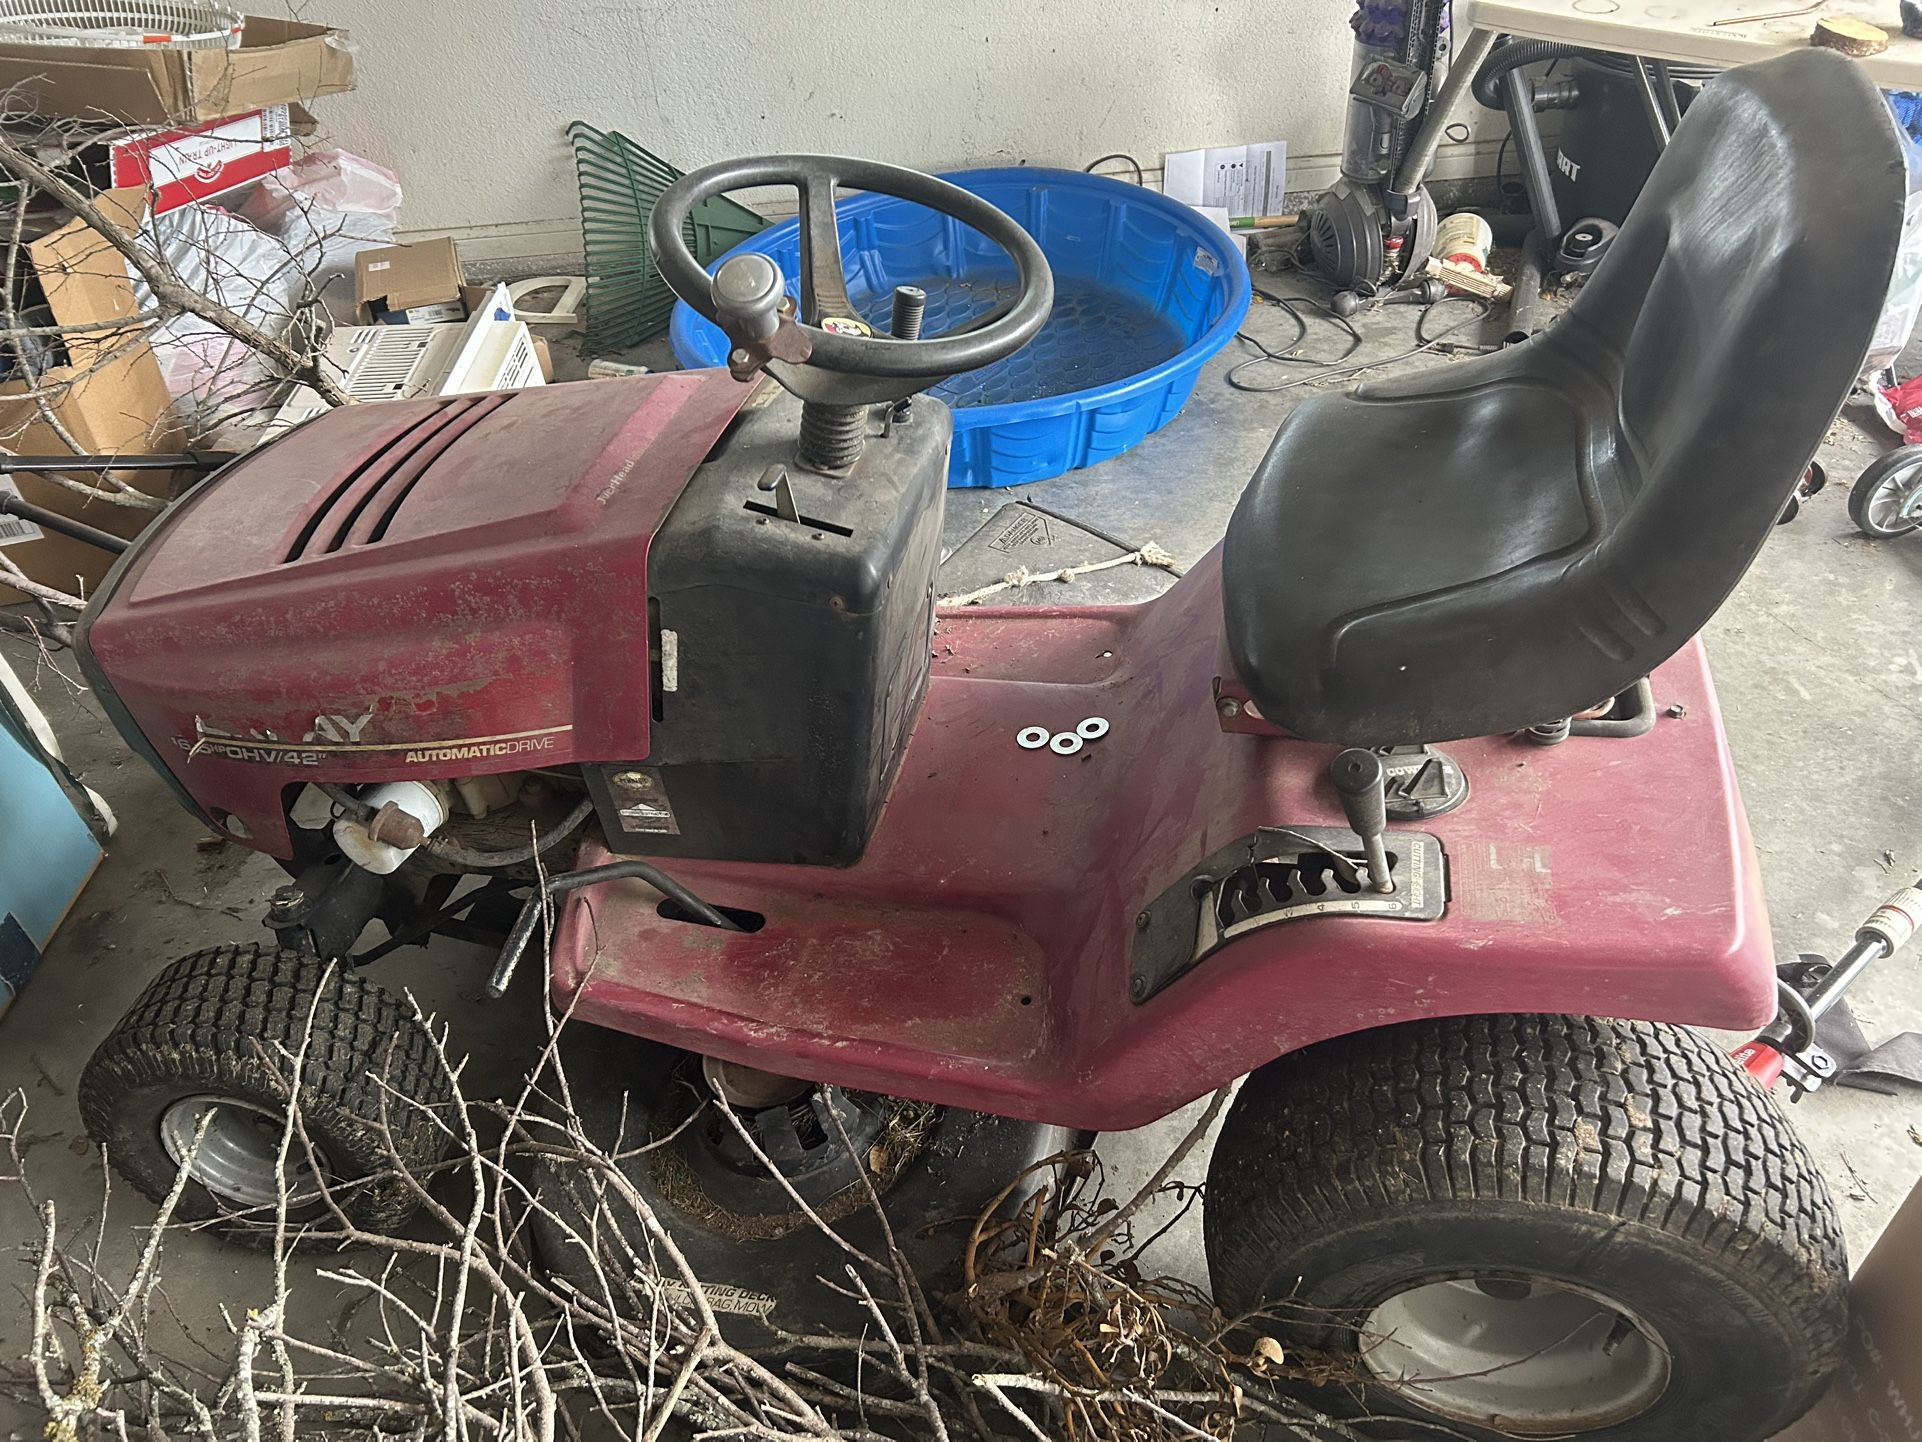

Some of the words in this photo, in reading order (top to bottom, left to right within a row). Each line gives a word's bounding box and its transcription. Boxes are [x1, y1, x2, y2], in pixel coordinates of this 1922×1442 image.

[1413, 842, 1422, 878] CUTTING
[1351, 901, 1360, 910] 5
[1388, 902, 1398, 910] 6
